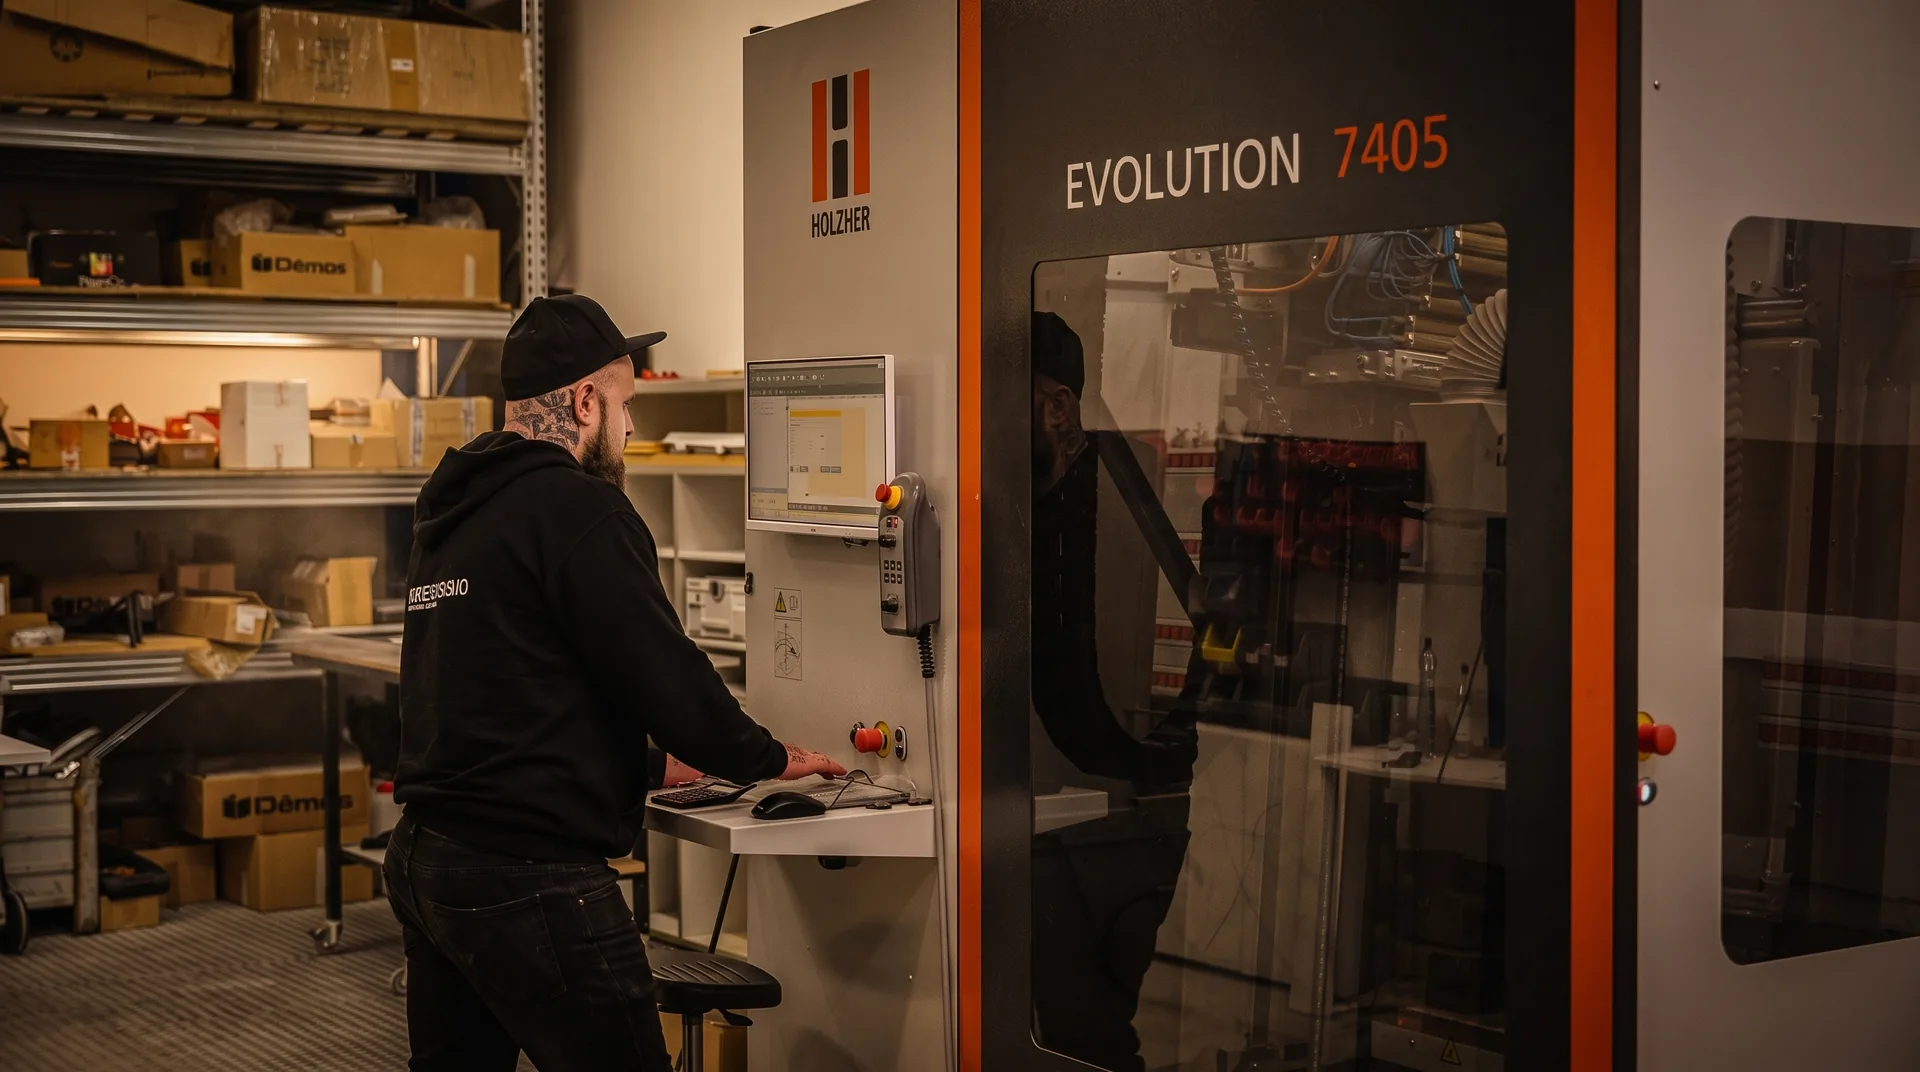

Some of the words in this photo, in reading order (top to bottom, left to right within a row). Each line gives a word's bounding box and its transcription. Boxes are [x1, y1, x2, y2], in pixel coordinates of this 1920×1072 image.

[1067, 133, 1300, 209] EVOLUTION
[1334, 114, 1448, 178] 7405
[811, 205, 870, 238] HOLZHER
[254, 794, 353, 816] Dêms
